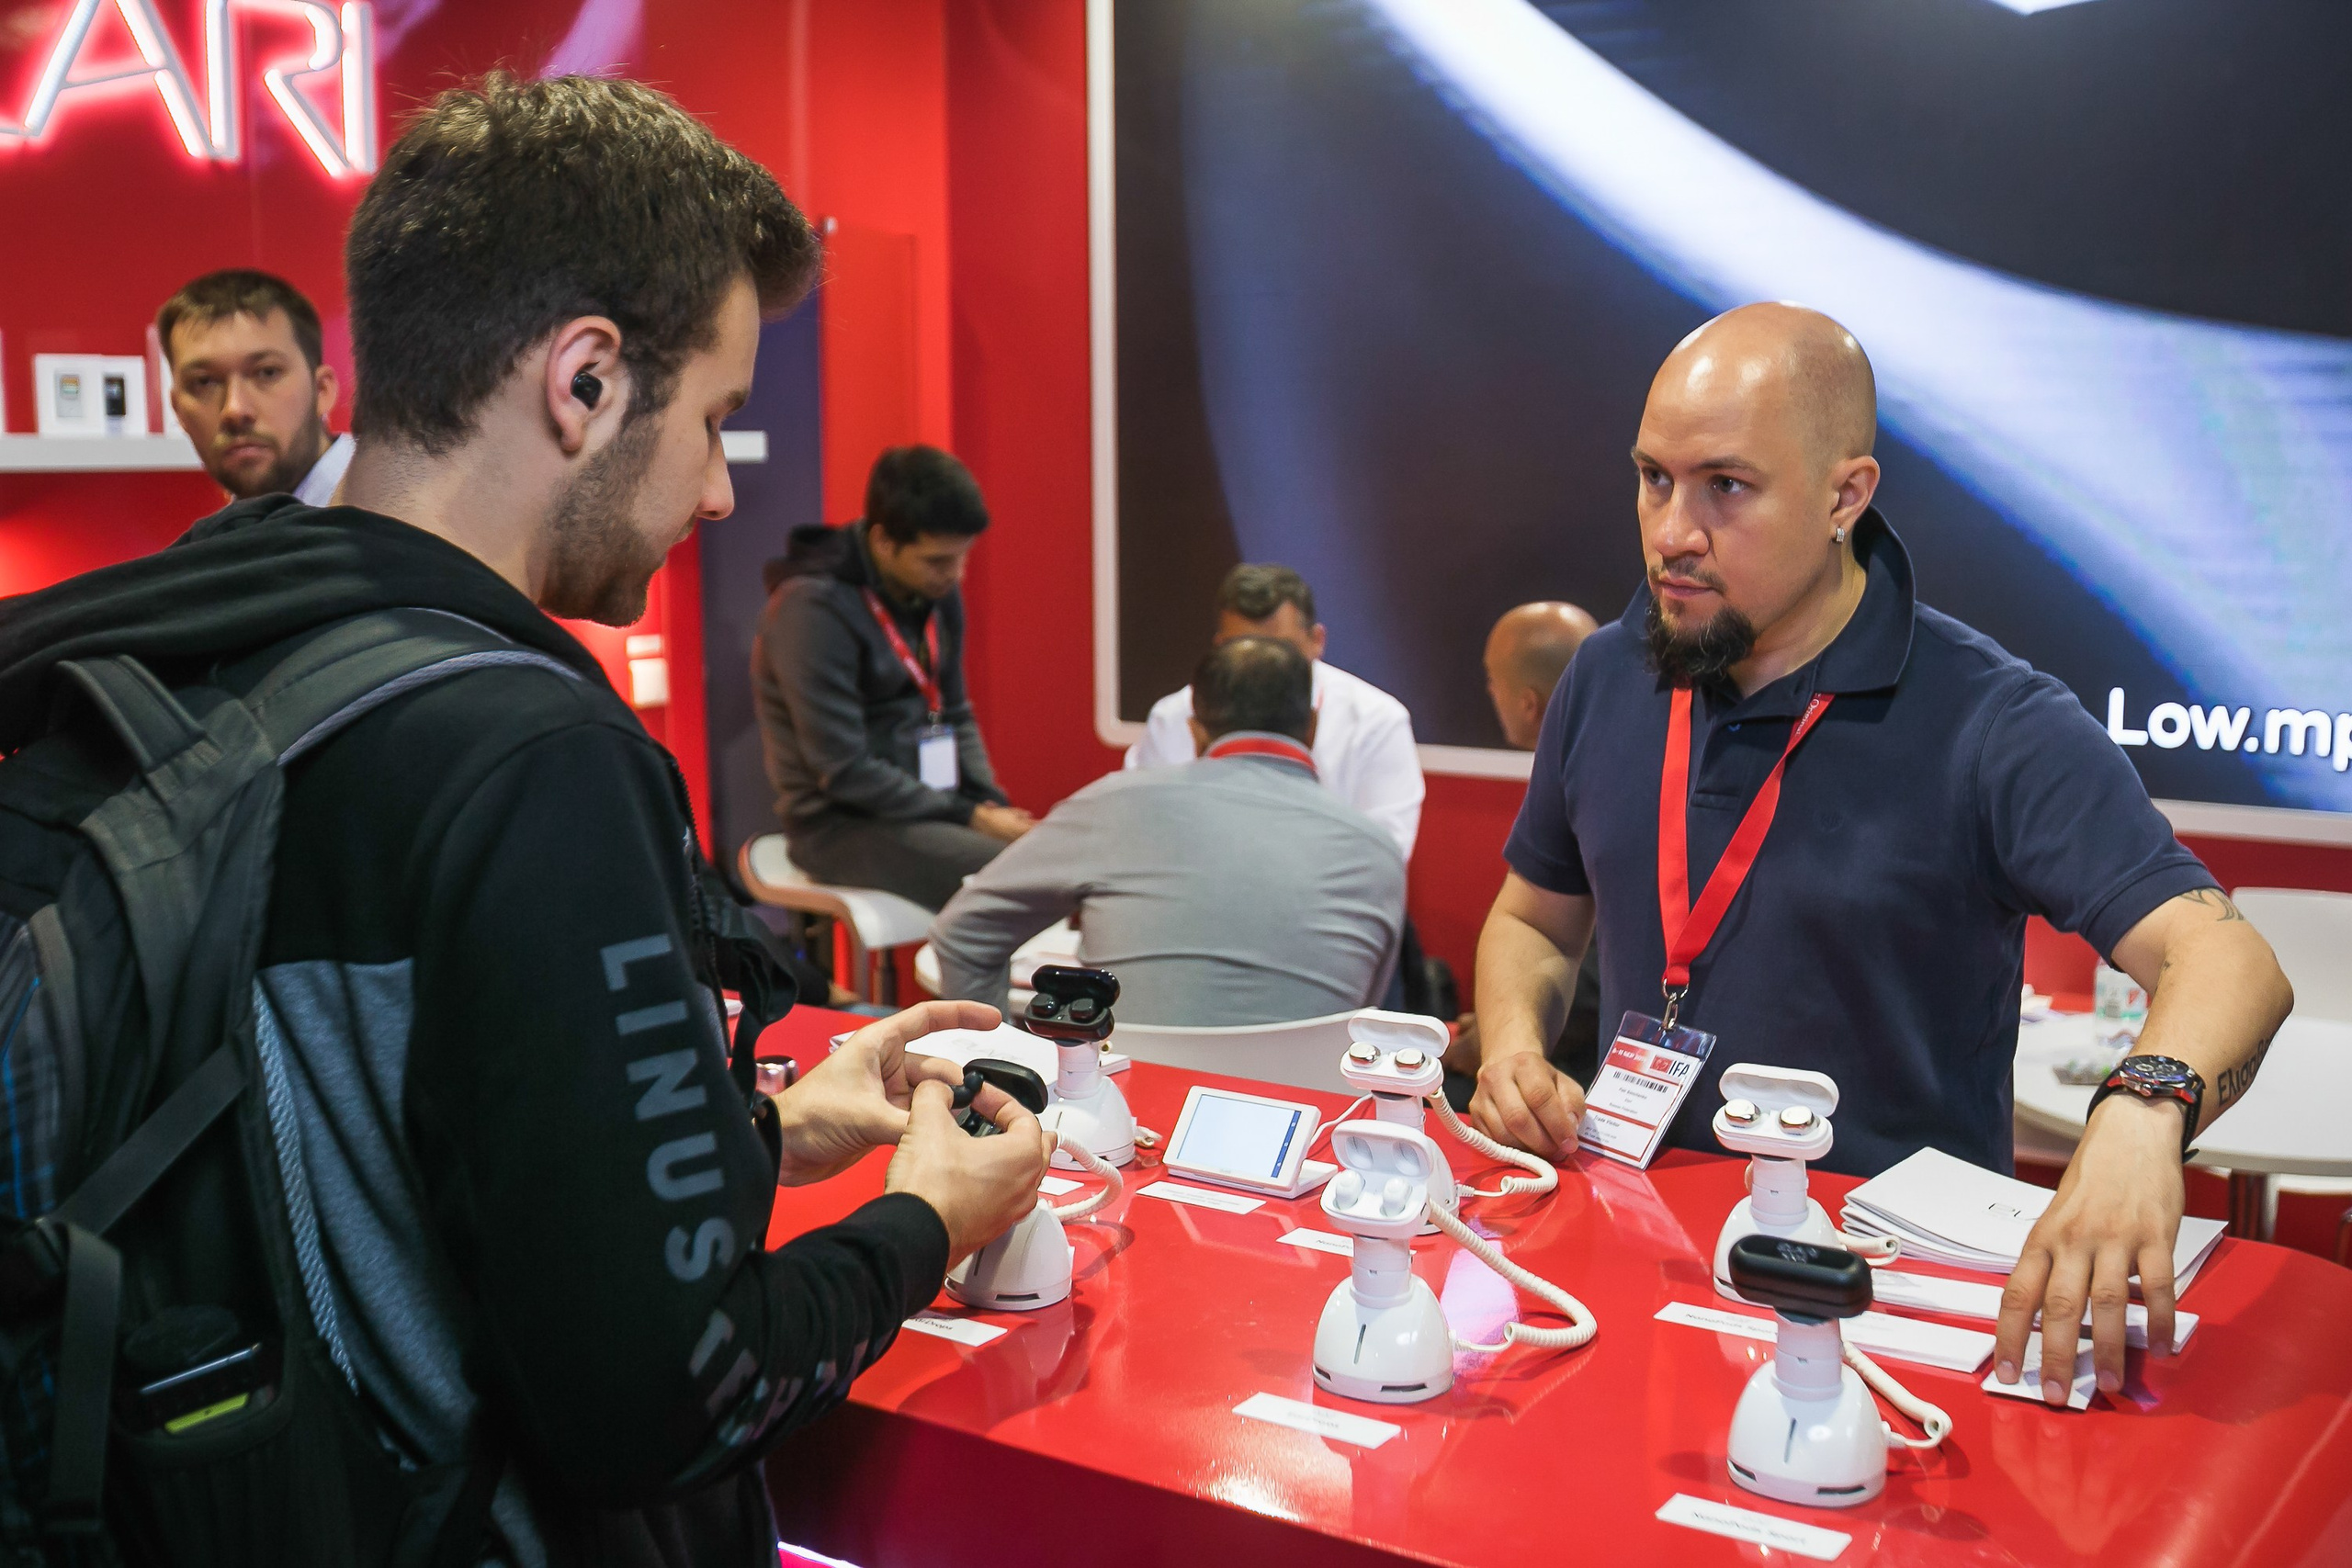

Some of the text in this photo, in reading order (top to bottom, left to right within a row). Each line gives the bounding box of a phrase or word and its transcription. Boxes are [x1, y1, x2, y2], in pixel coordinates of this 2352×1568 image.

[0, 0, 378, 177] ARI
[600, 933, 735, 1283] LINUS
[1668, 1060, 1690, 1077] IFA
